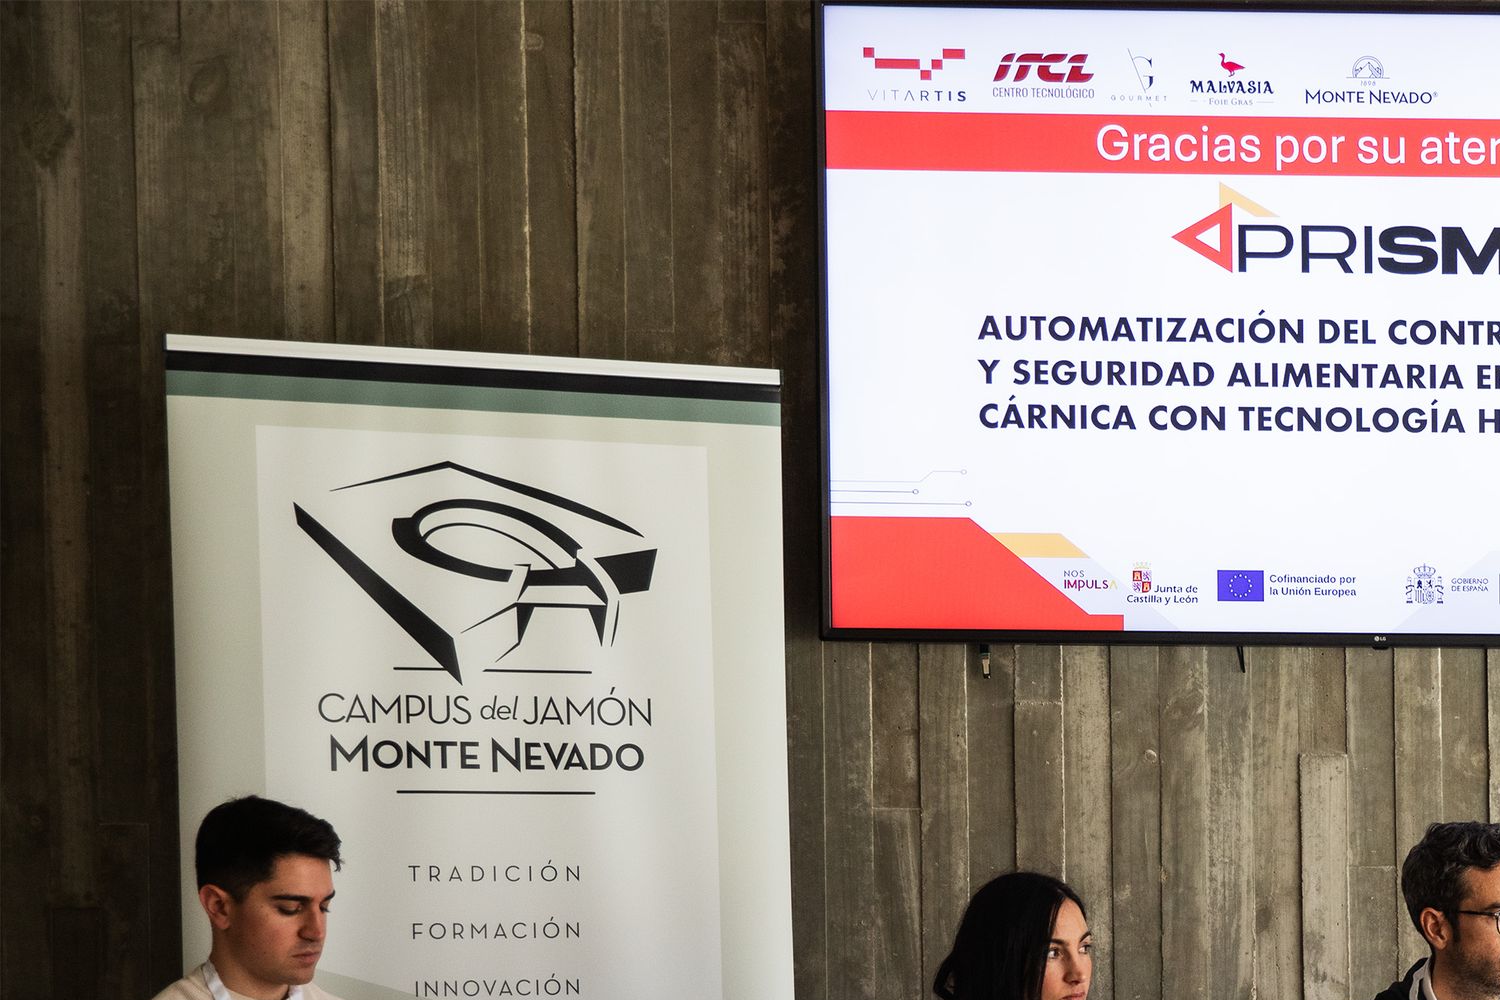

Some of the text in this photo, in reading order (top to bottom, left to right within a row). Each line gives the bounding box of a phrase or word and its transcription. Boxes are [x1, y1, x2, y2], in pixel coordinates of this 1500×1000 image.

[993, 86, 1094, 98] CENTRO TECNOLÓGICO
[1190, 80, 1273, 94] MALVASIA
[868, 90, 966, 102] VITARTIS
[1306, 89, 1364, 104] MONTE
[1097, 124, 1261, 162] Gracias
[1276, 135, 1345, 171] por
[1358, 136, 1405, 164] su
[978, 309, 1303, 343] AUTOMATIZACIÓN
[1319, 319, 1376, 344] DEL
[978, 360, 1000, 384] Y
[1013, 360, 1214, 386] SEGURIDAD
[1227, 363, 1463, 389] ALIMENTARIA
[979, 395, 1136, 430] CÁRNICA
[1149, 405, 1225, 431] CON
[1238, 399, 1465, 433] TECNOLOGÍA
[1064, 570, 1084, 578] NOS
[1269, 574, 1356, 585] Cofinanciado por
[1451, 577, 1489, 586] GOBIERNO
[1154, 584, 1198, 594] Junta de
[1270, 587, 1356, 597] la Unión Europea
[1127, 593, 1199, 605] Castilla y León
[318, 687, 651, 726] CAMPUS del JAMÓN
[330, 735, 644, 772] MONTE NEVADO
[408, 860, 579, 882] TRADICIÓN
[412, 916, 579, 939] FORMACIÓN
[416, 973, 581, 998] INNOVACIÓN
